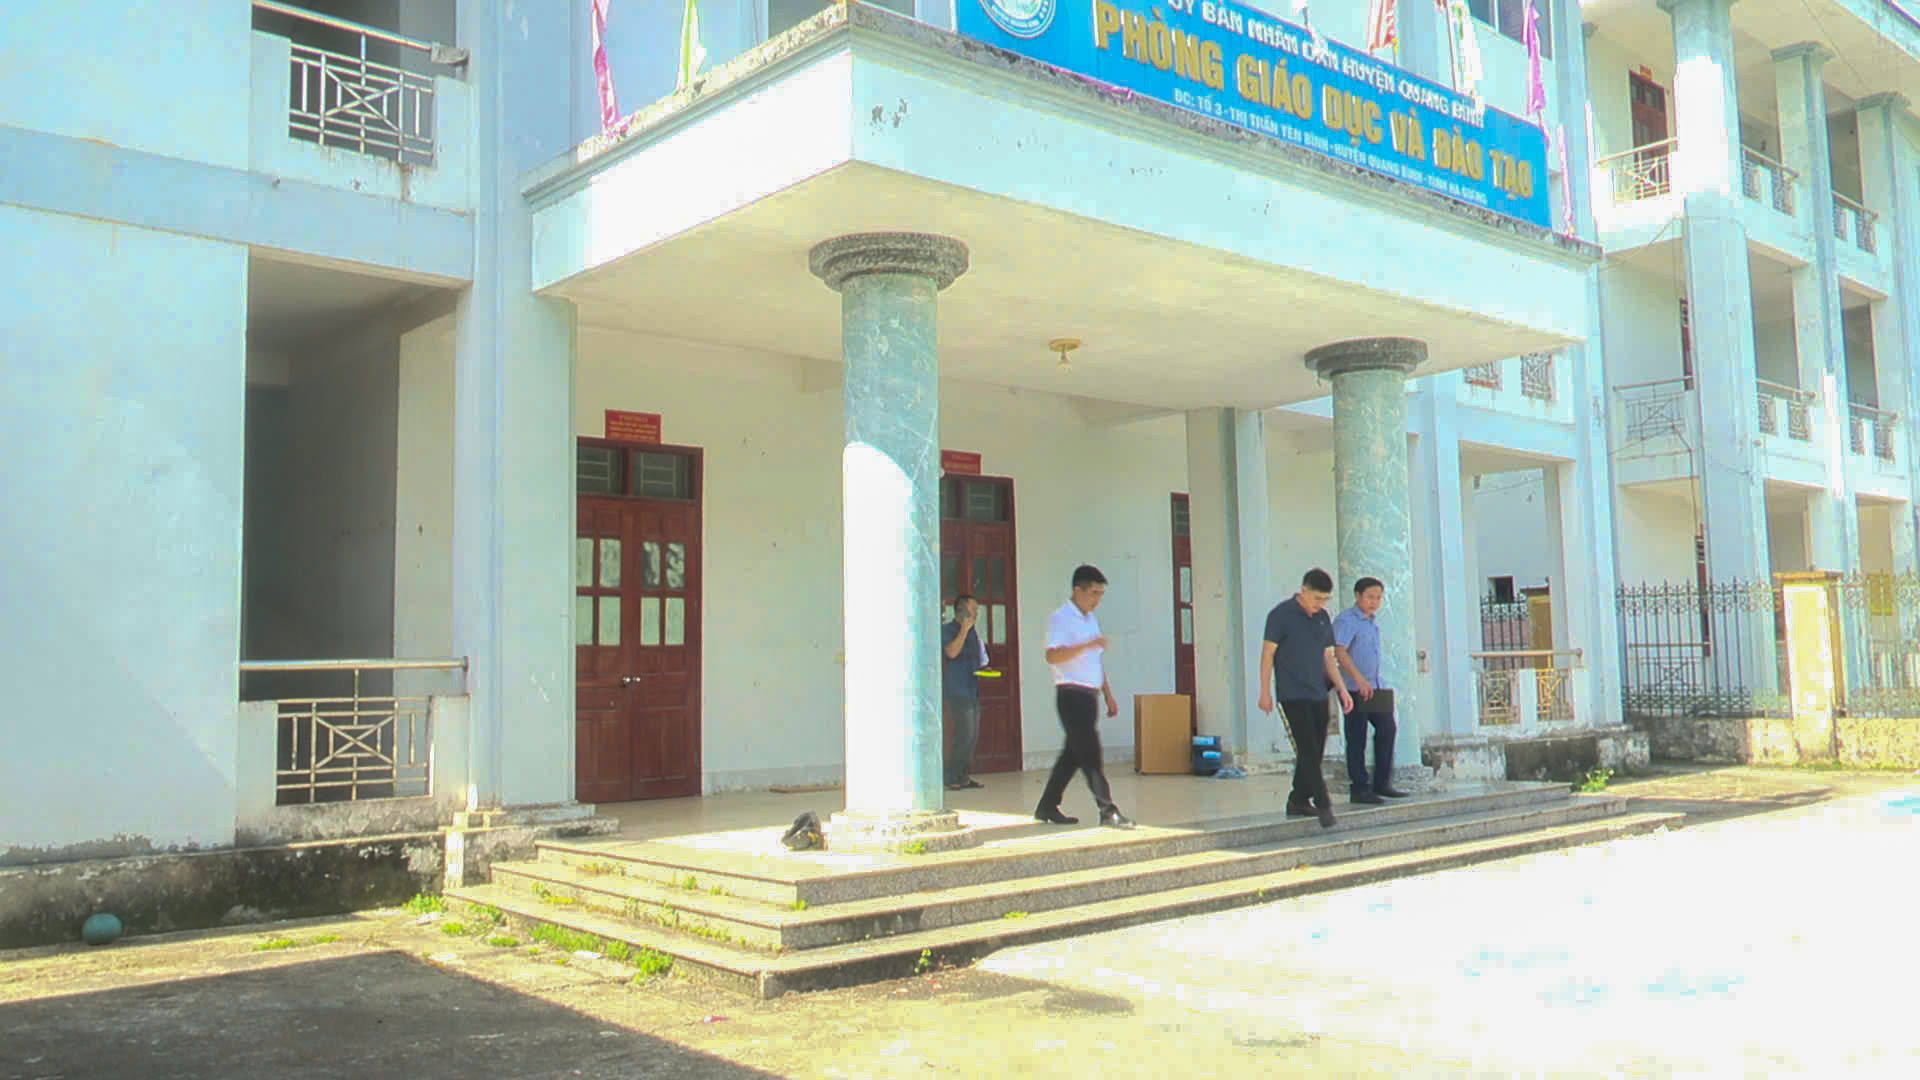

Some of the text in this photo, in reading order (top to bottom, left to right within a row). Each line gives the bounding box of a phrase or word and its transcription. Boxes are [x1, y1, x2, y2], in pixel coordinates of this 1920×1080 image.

[1093, 1, 1223, 91] PHÒNG
[1237, 53, 1312, 120] GIÁO
[1323, 83, 1382, 146] DỤC
[1389, 107, 1424, 160] VÀ
[1432, 123, 1483, 180] ĐÀO
[1489, 149, 1532, 200] TẠO
